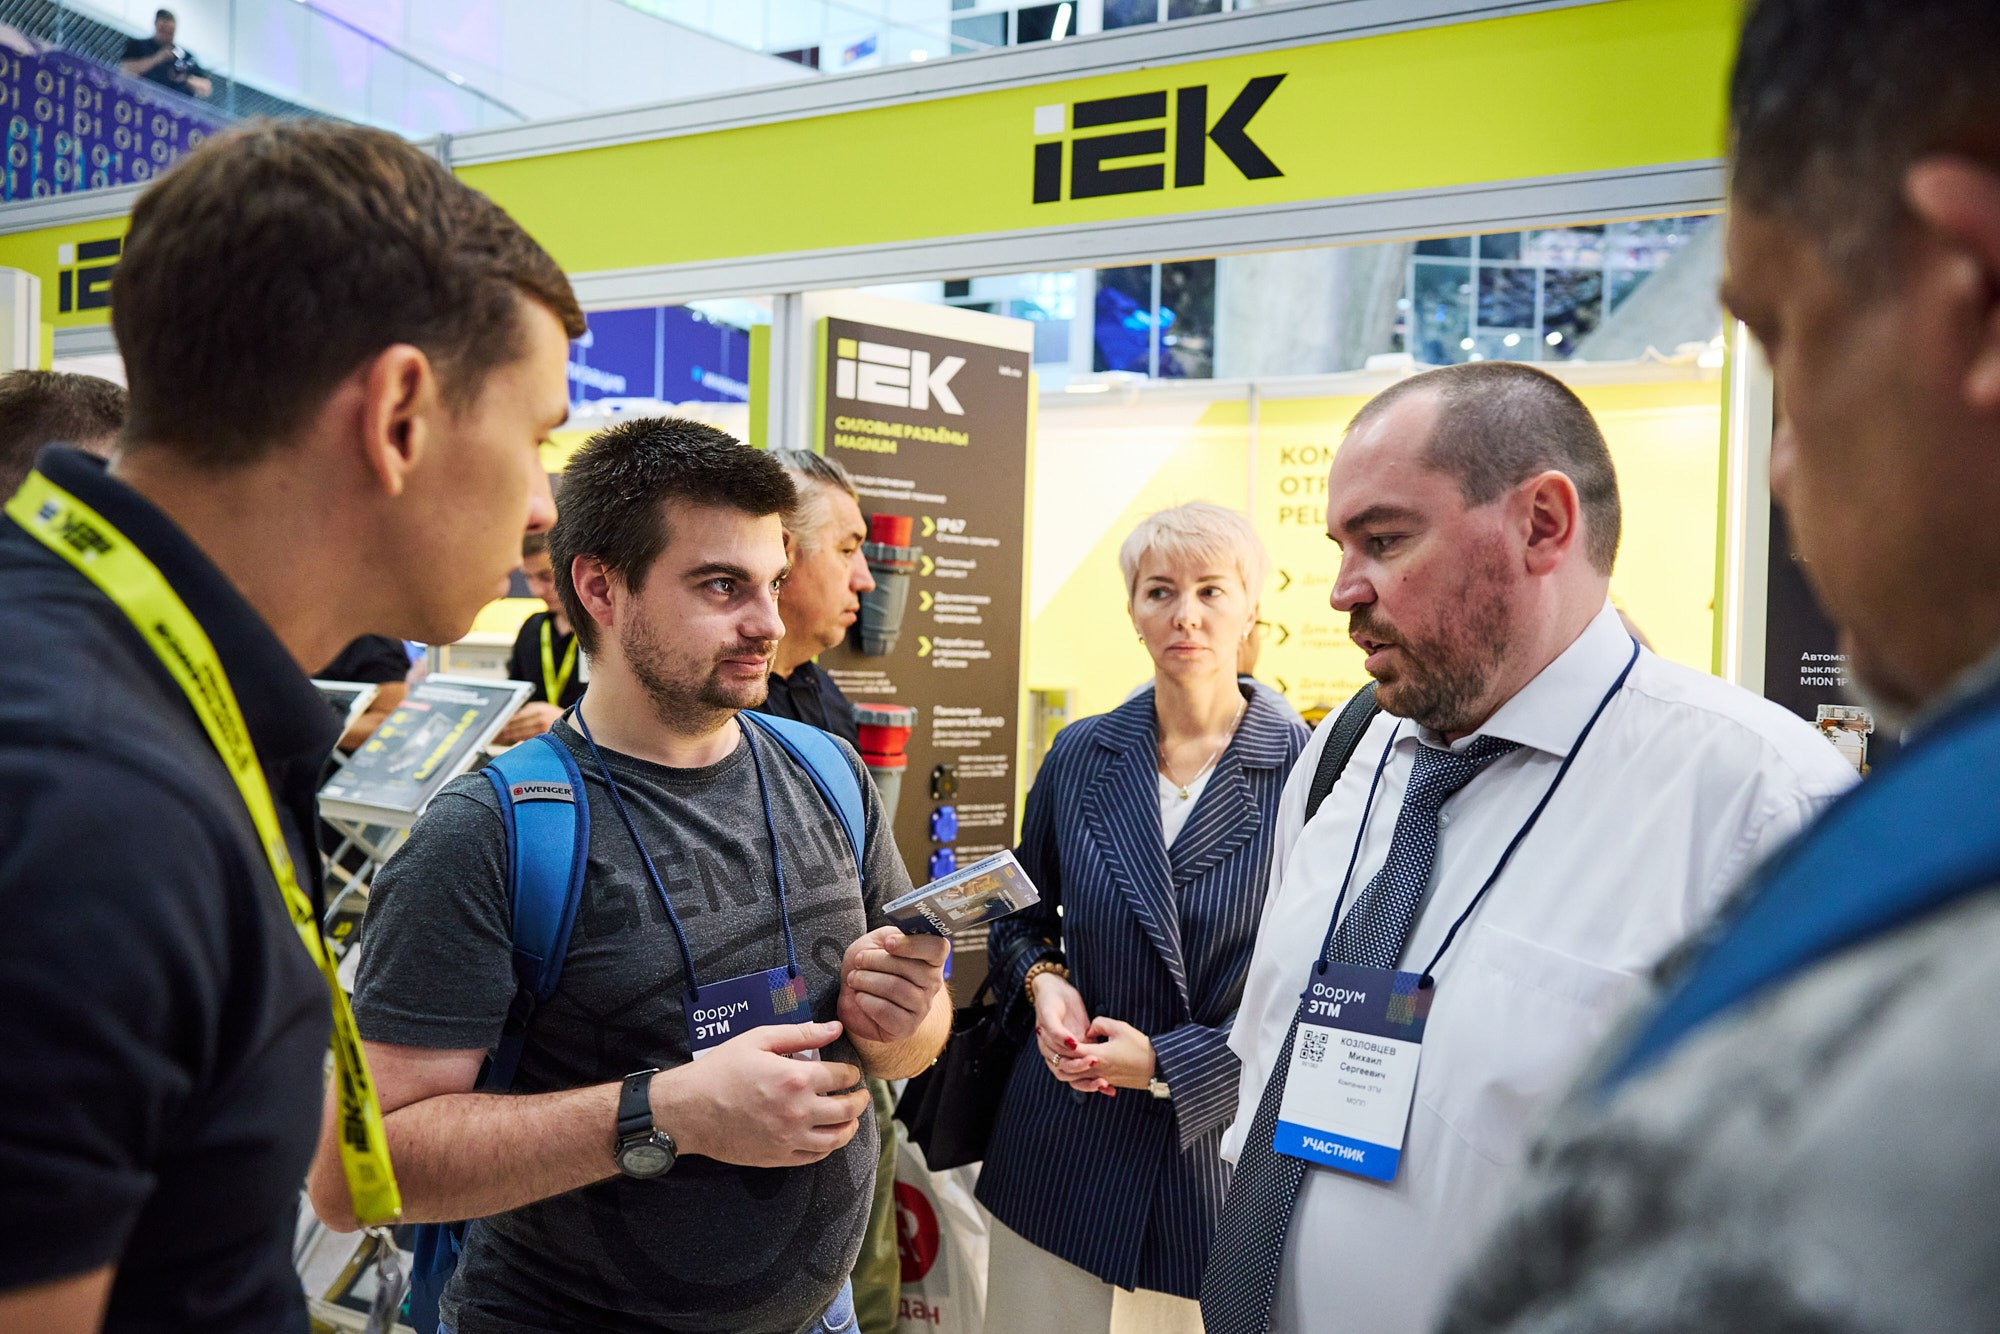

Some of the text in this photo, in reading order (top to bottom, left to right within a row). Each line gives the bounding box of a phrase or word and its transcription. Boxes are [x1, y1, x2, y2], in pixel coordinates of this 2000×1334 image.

[58, 238, 121, 313] iE
[1800, 676, 1834, 686] M10N
[523, 786, 572, 796] WENGER
[914, 900, 952, 936] ПРОГРАММА
[1312, 982, 1366, 1005] Форум
[693, 1000, 749, 1023] Форум
[1307, 999, 1342, 1018] ЭТМ
[695, 1019, 731, 1040] ЭТМ
[1340, 1037, 1397, 1056] КОЗЛОВЦЕВ
[1348, 1050, 1382, 1066] Михаил
[1339, 1061, 1386, 1080] Сергеевич
[1302, 1136, 1366, 1163] УЧАСТНИК
